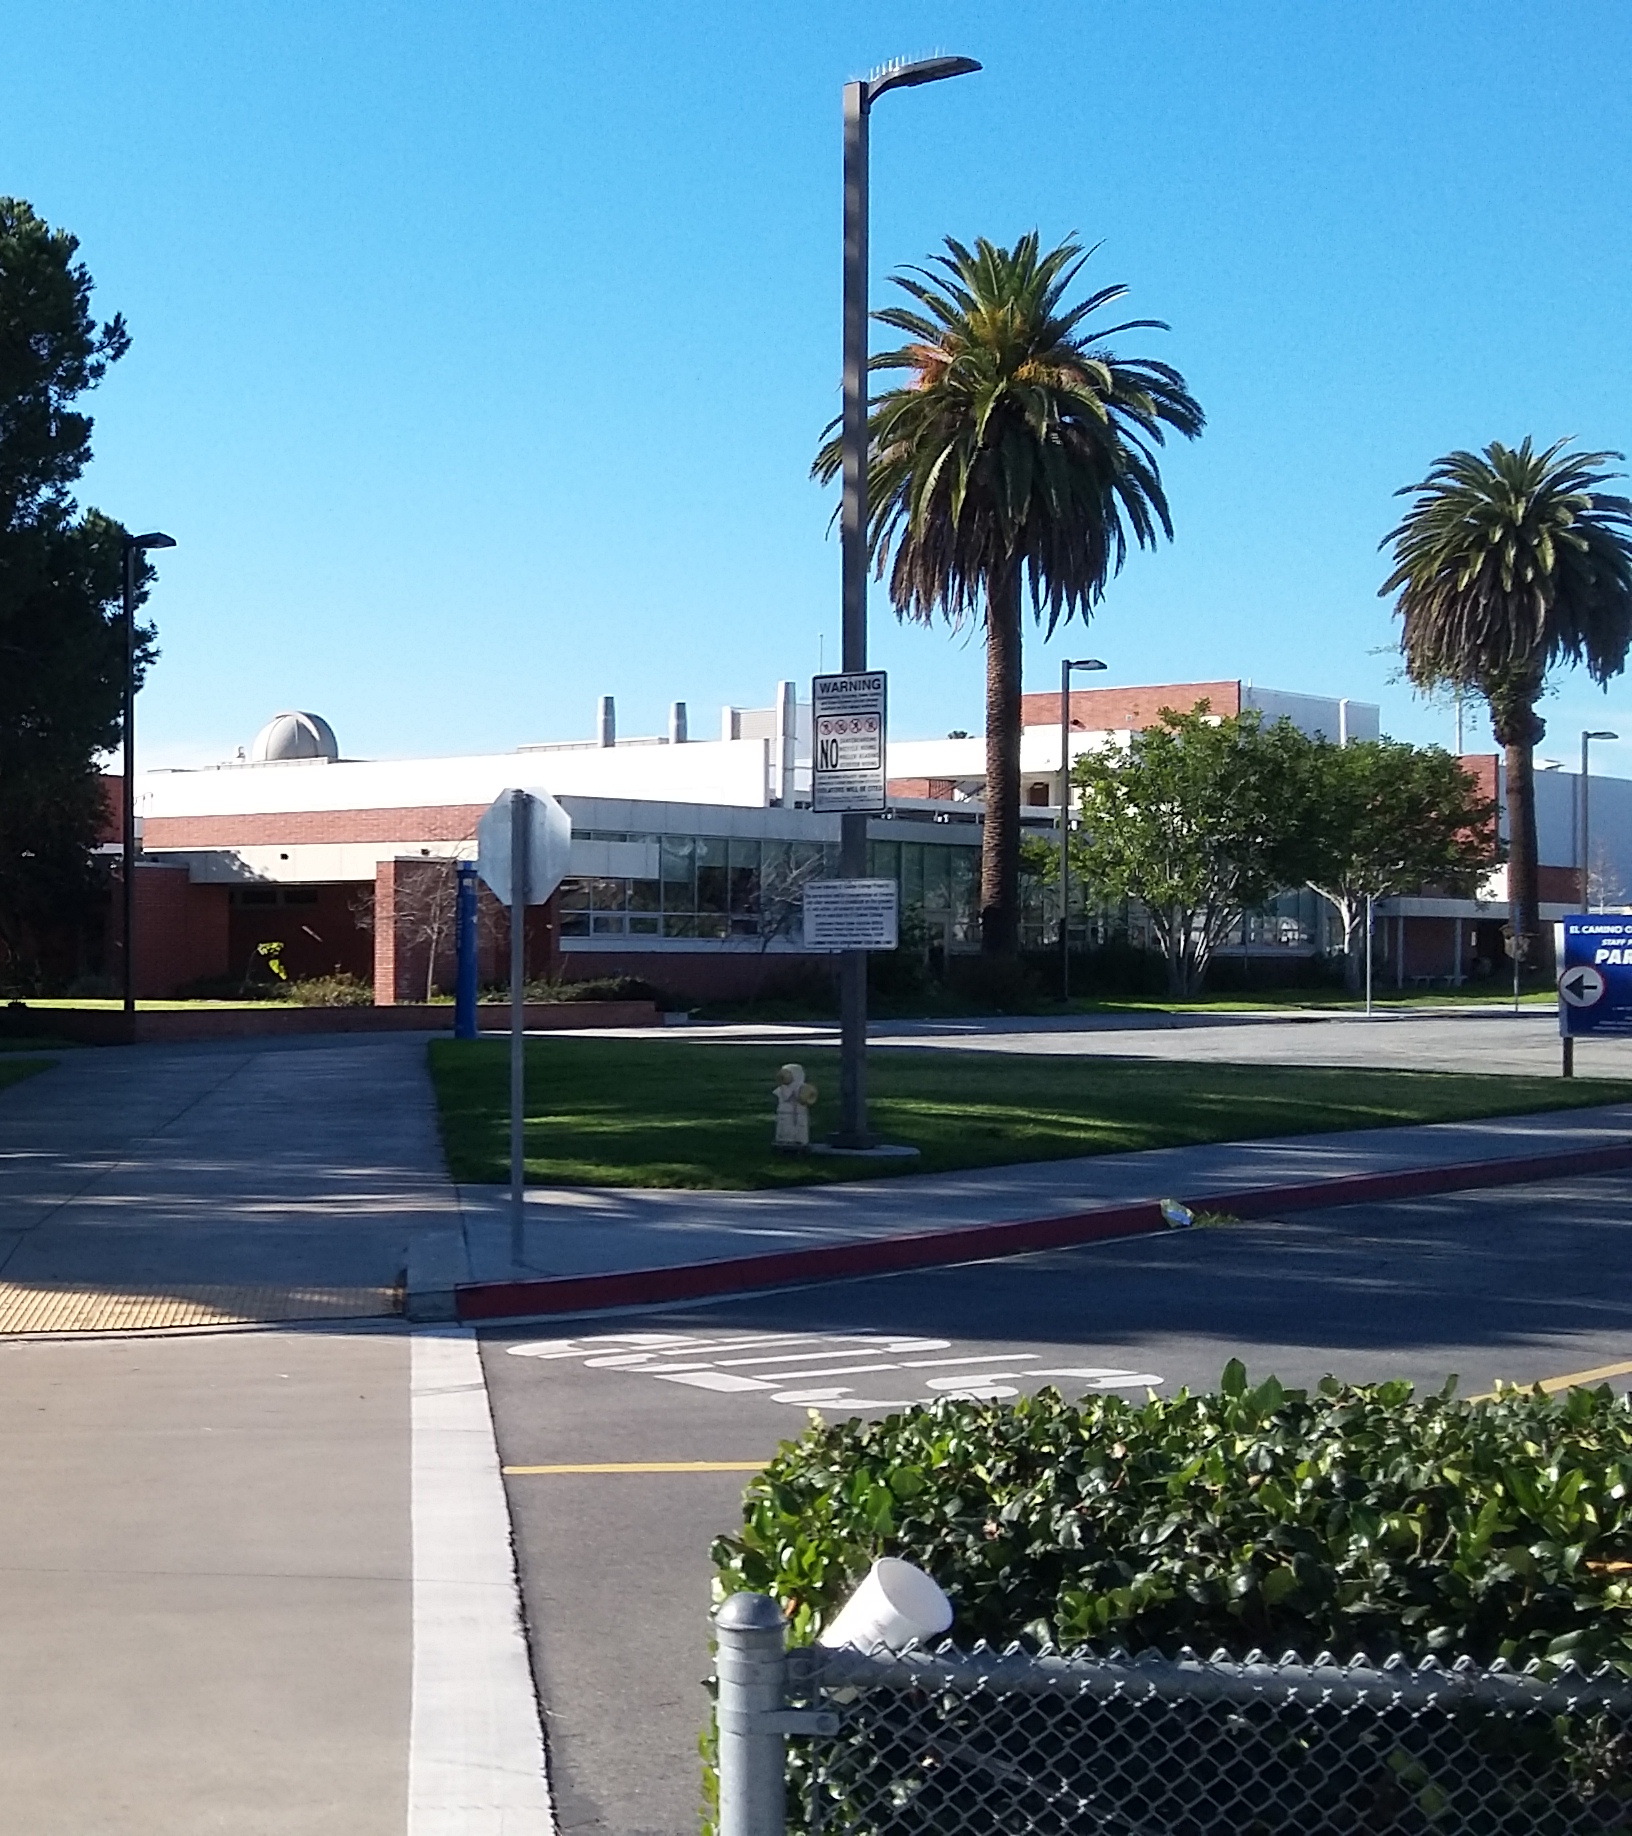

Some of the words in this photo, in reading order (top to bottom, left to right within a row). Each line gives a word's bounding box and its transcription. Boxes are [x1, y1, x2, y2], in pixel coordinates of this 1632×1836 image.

[820, 678, 881, 694] WARNING
[820, 738, 839, 769] NO
[1569, 925, 1580, 934] EL
[1581, 925, 1623, 934] CAMINO
[1601, 938, 1626, 946] STAFF
